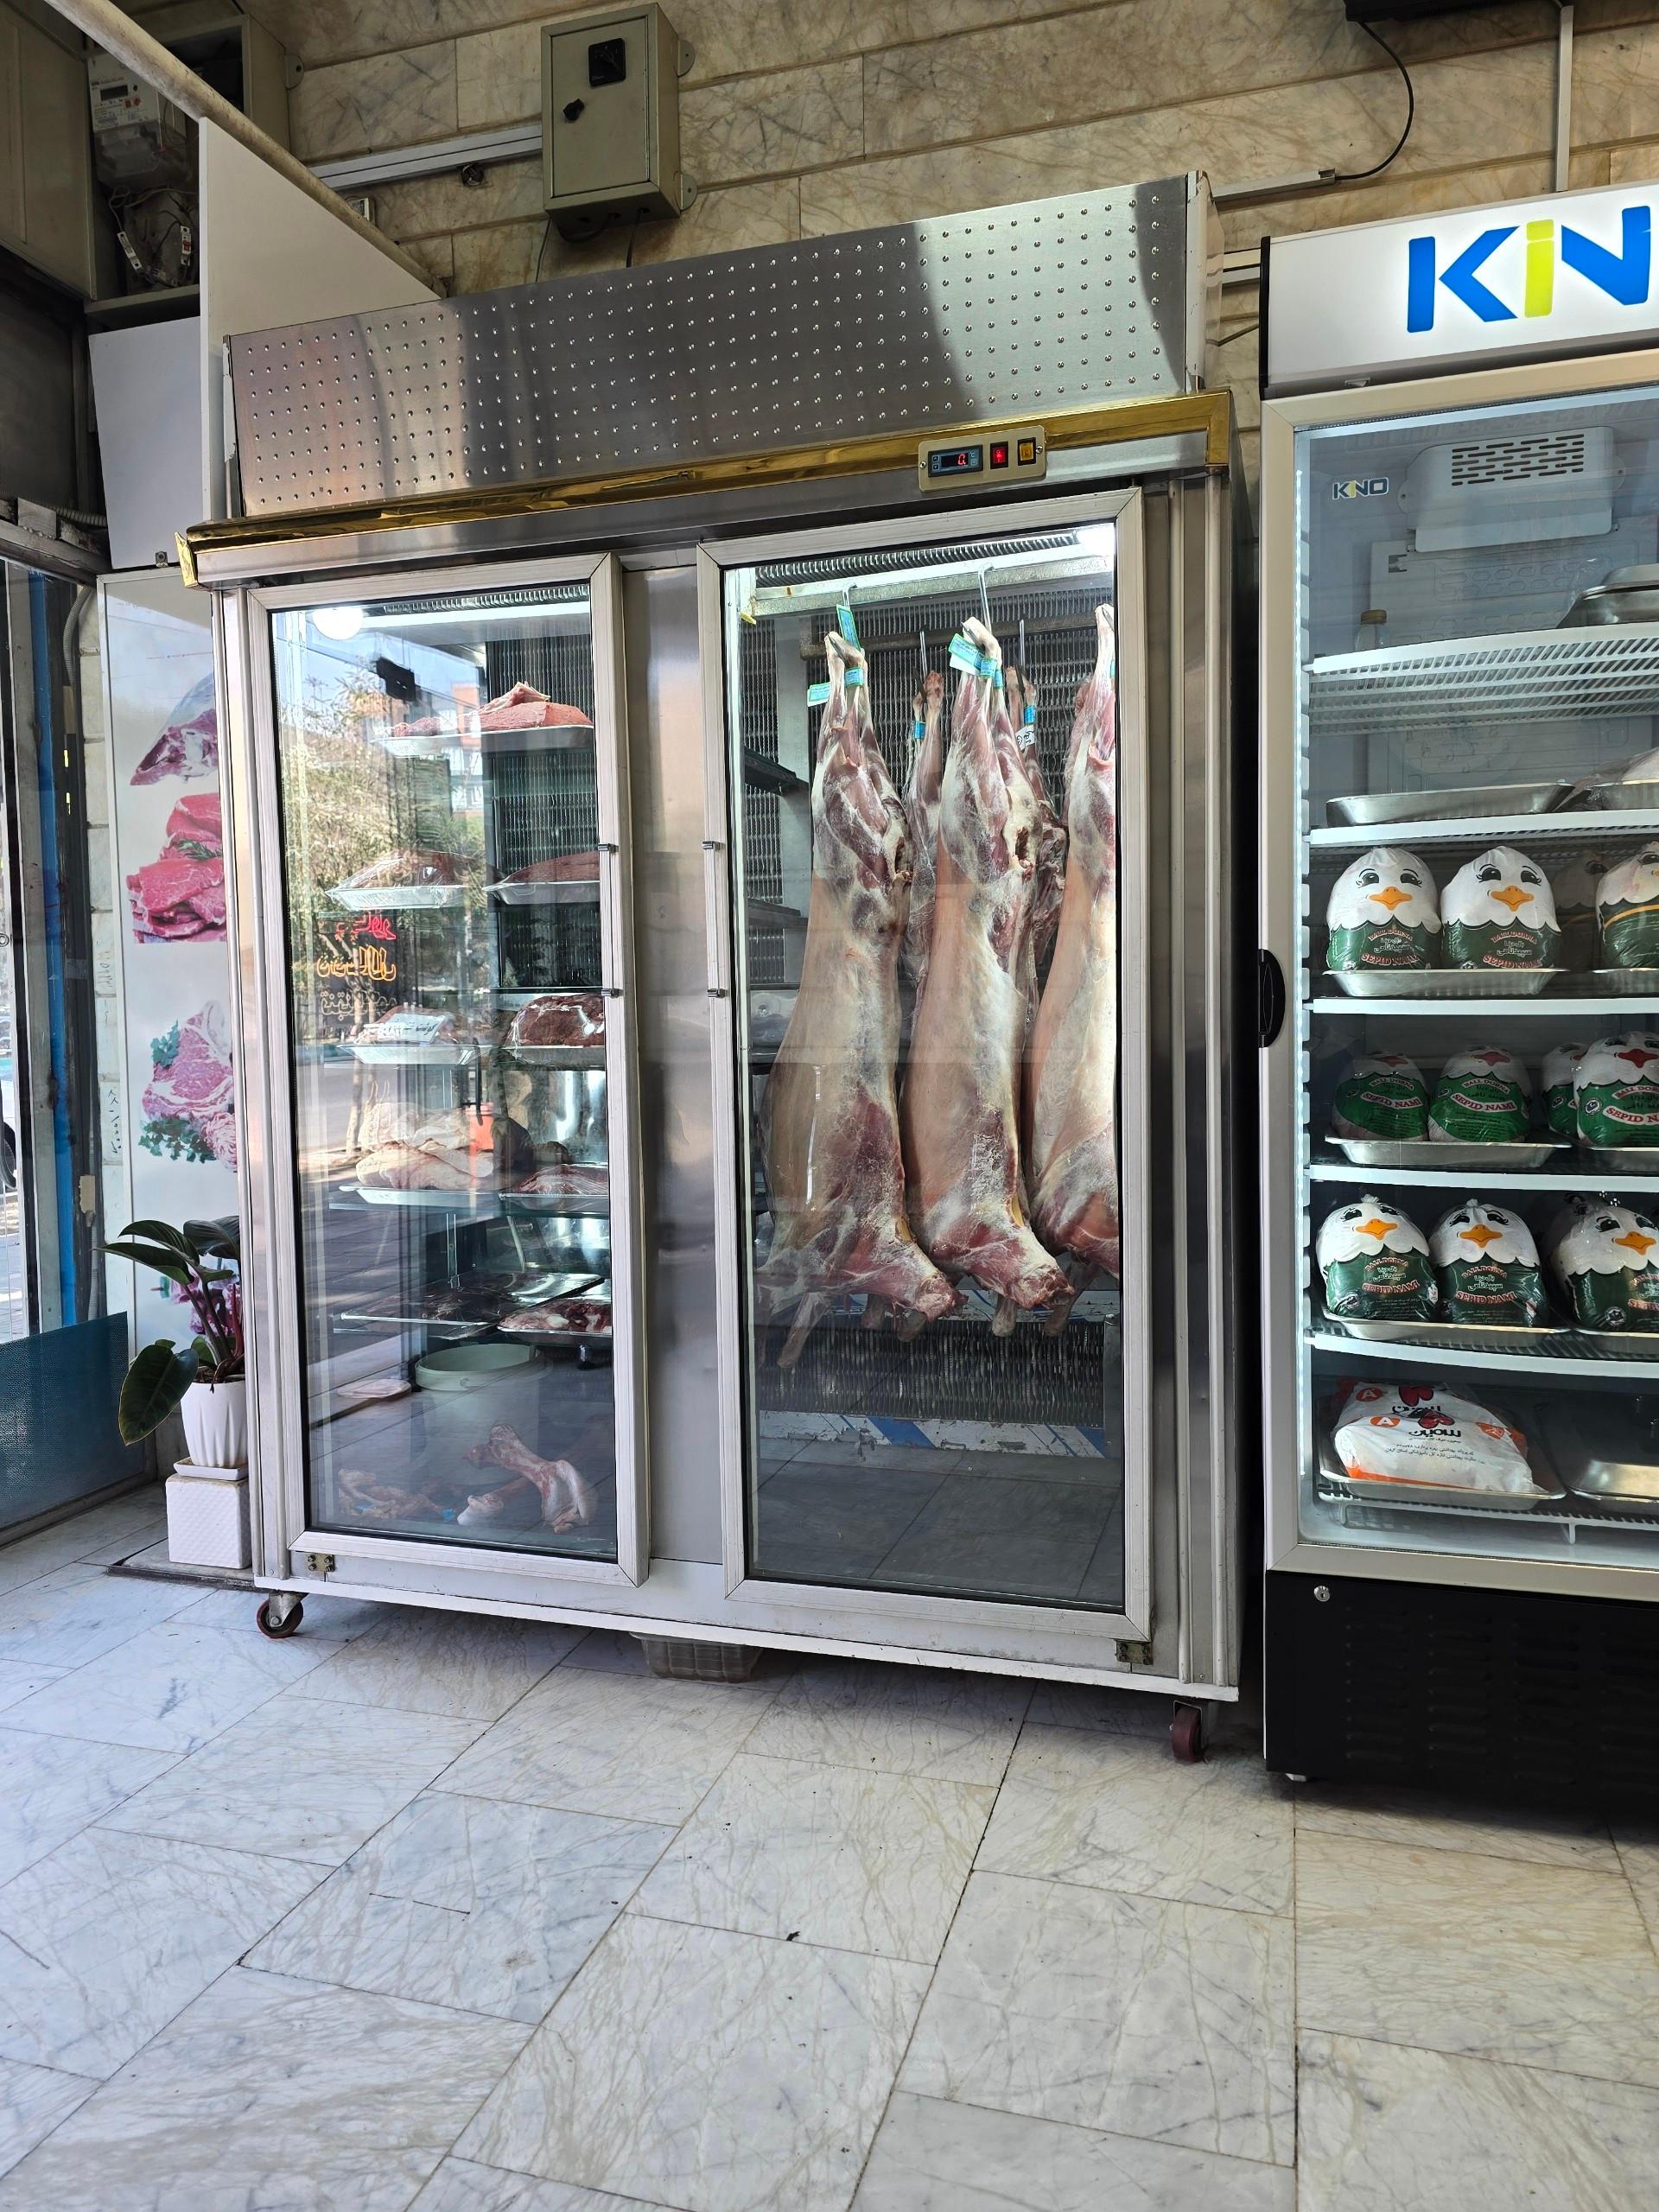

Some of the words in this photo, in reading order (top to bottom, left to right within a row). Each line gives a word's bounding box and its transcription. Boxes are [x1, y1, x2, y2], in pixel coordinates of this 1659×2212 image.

[1363, 1092, 1393, 1107] SEPID
[1452, 1094, 1483, 1110] SEPID
[1485, 1101, 1516, 1111] NAMI
[1605, 1107, 1643, 1122] SEPID
[1455, 1291, 1486, 1304] SEPID
[1376, 1416, 1395, 1426] A
